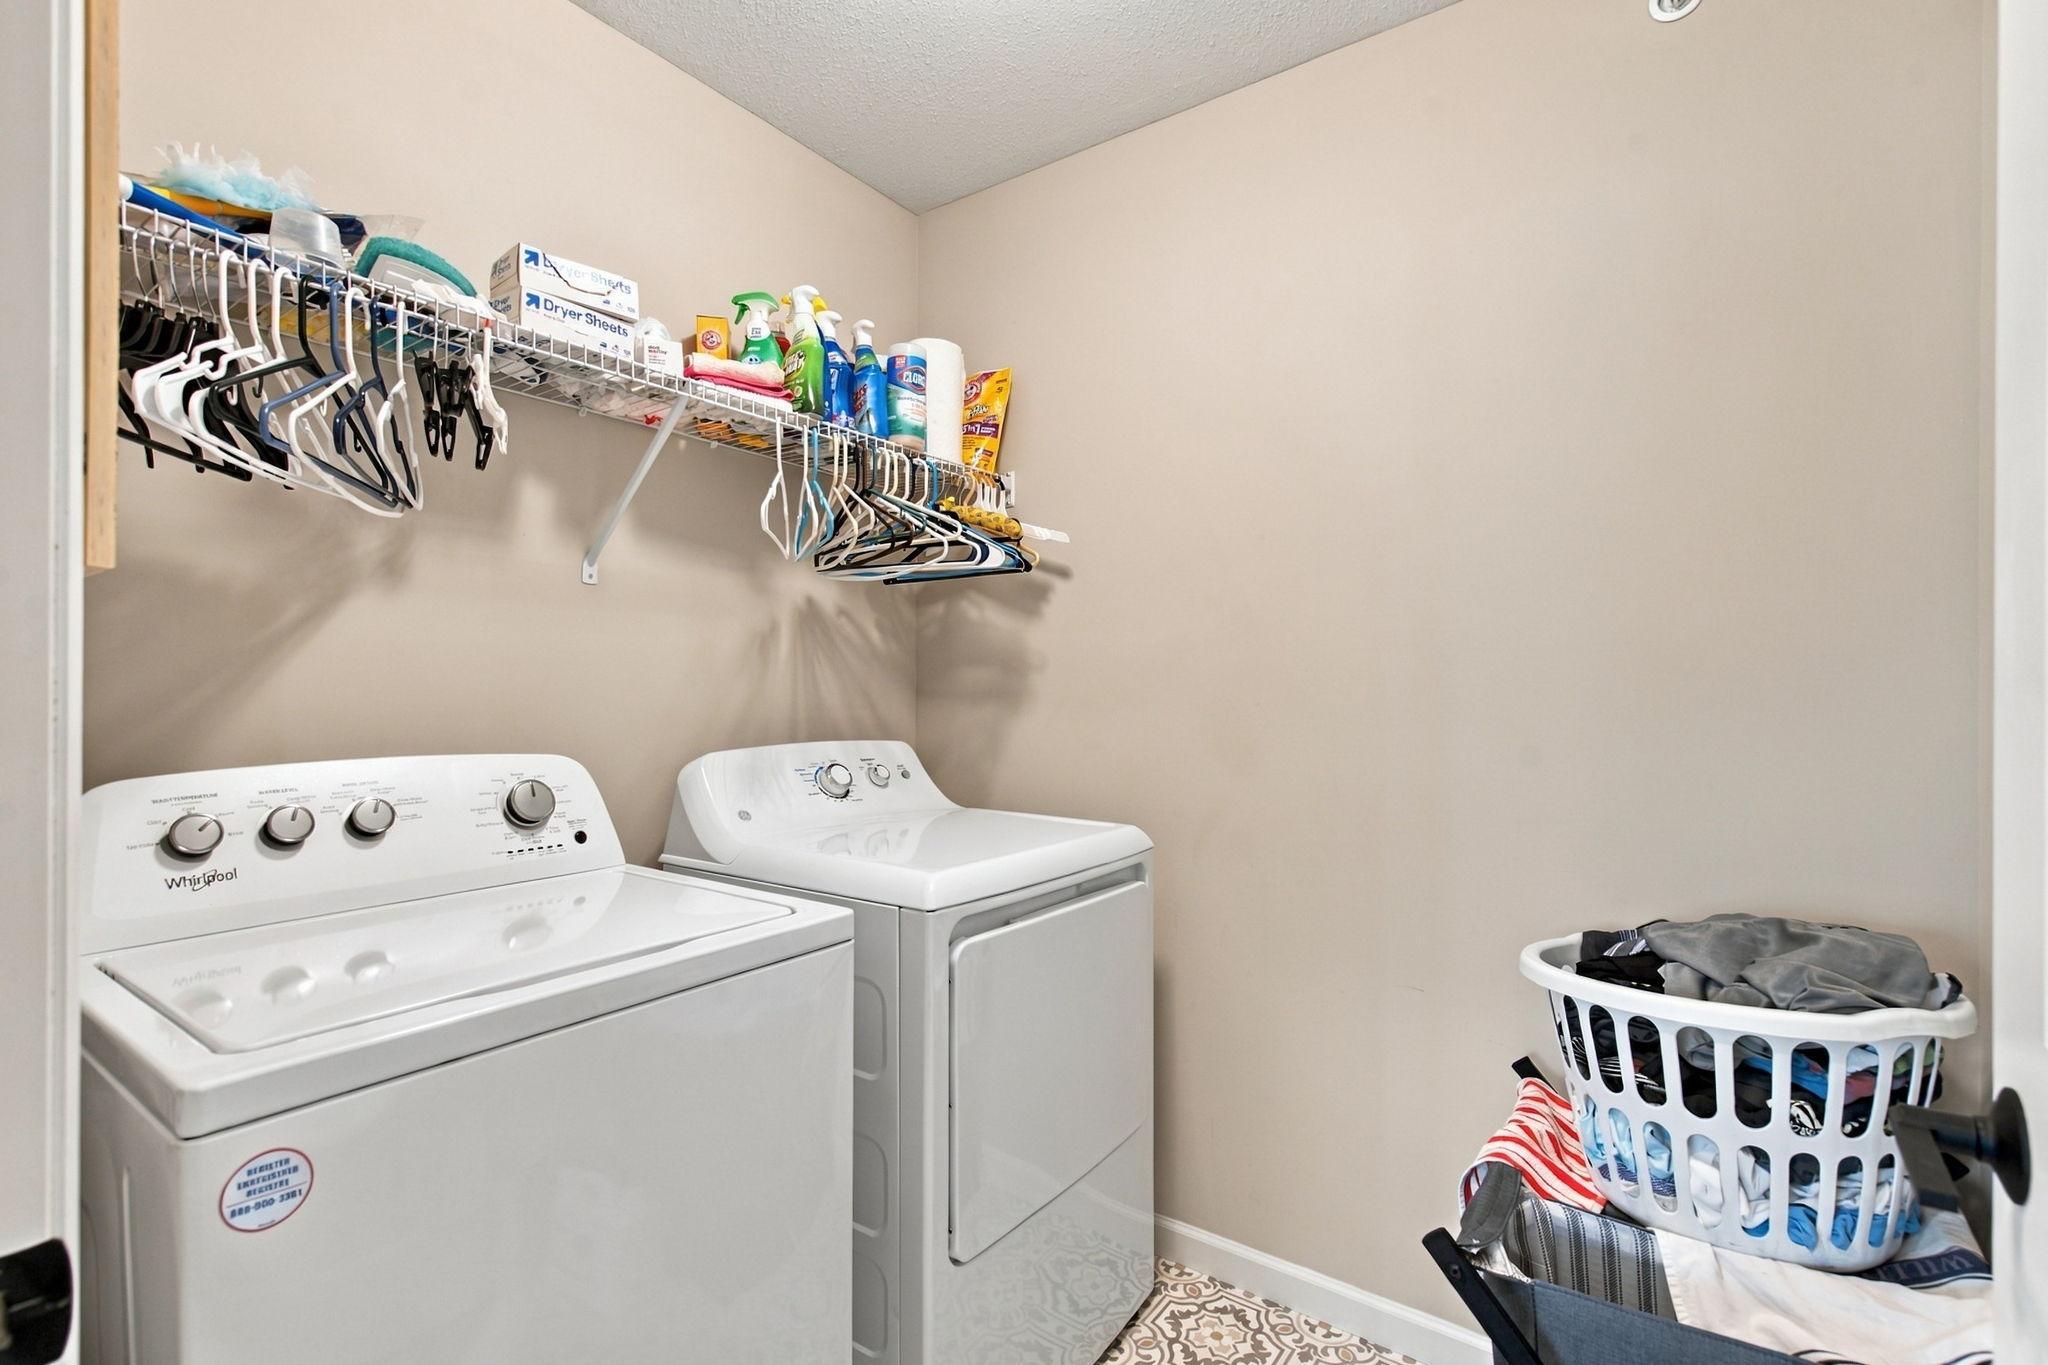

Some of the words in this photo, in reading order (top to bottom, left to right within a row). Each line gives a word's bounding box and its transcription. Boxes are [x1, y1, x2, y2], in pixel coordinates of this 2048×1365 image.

[543, 298, 583, 321] Dryer
[585, 312, 629, 338] Sheets
[164, 867, 238, 892] Whirlpool
